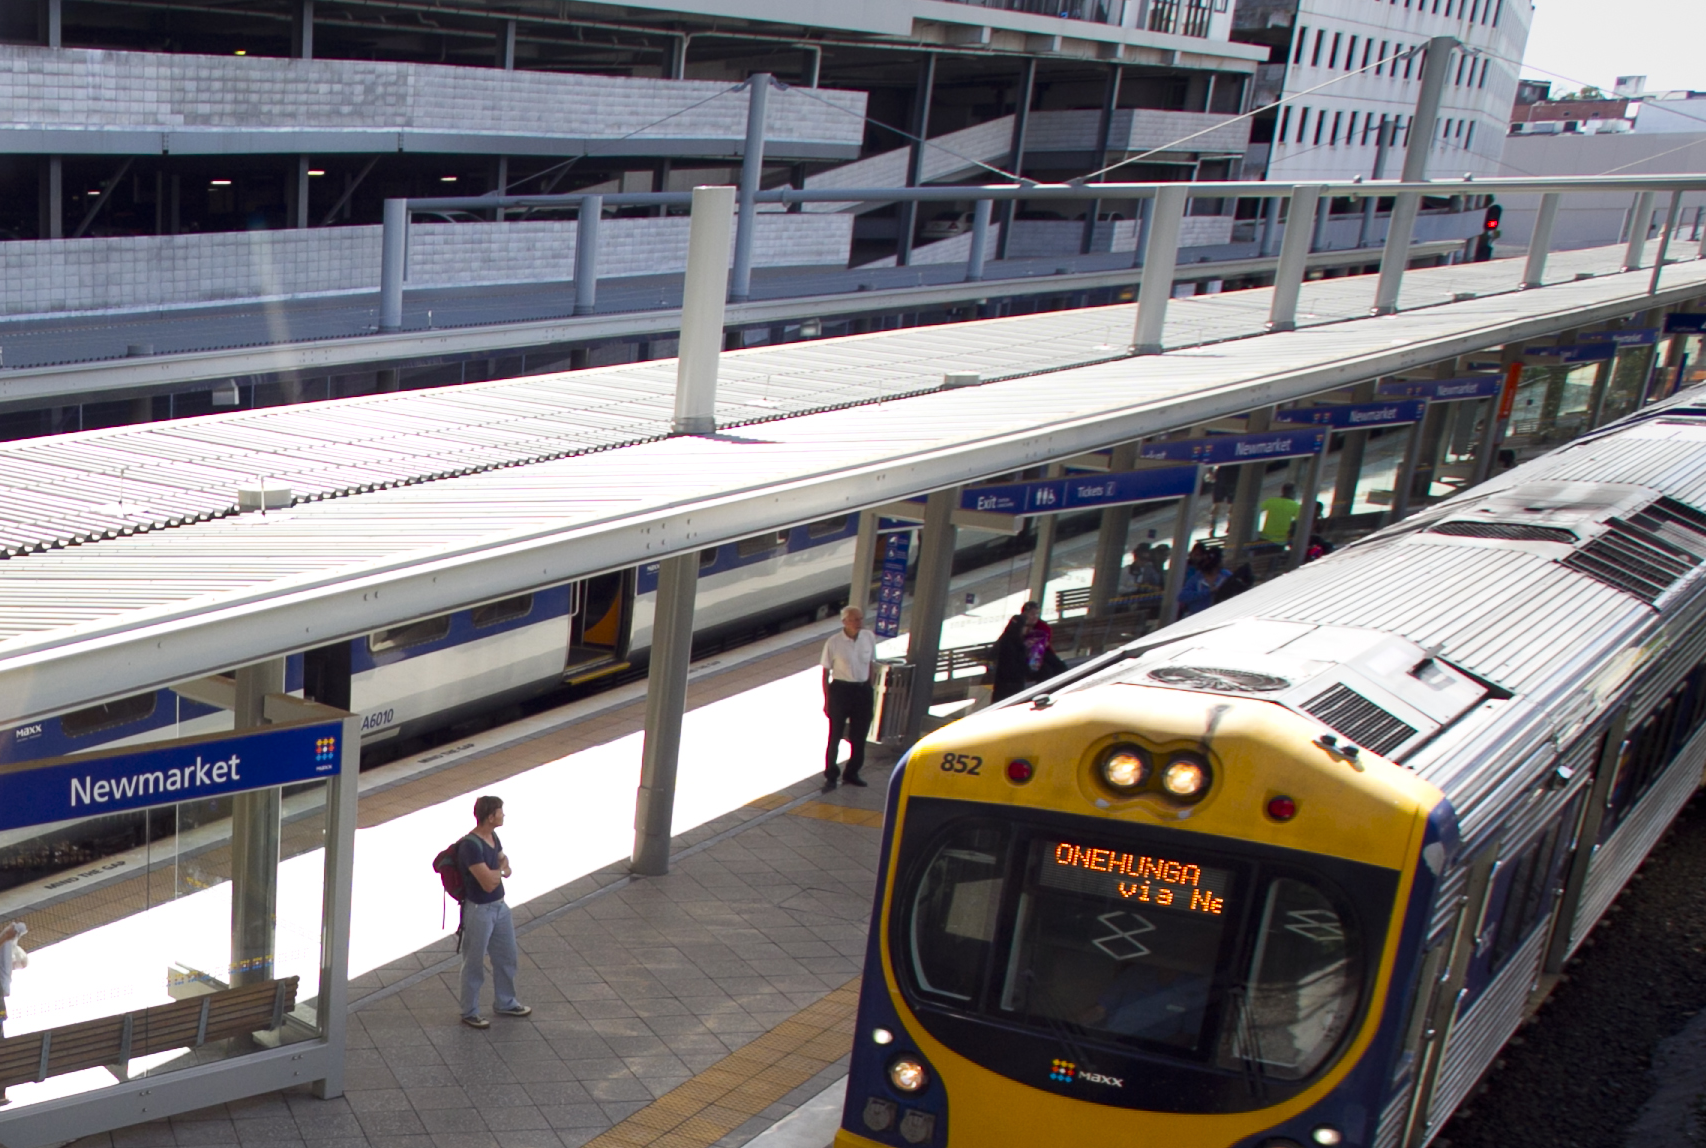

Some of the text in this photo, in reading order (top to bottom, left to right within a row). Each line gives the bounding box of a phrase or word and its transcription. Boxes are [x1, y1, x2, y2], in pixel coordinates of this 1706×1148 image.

[1349, 407, 1397, 422] Newmarket
[1234, 438, 1292, 456] Newmarket
[977, 495, 997, 510] Exit
[940, 752, 983, 776] 852
[70, 754, 241, 807] Newmarket
[1055, 842, 1201, 886] ONEHUNGA
[1118, 880, 1174, 905] via
